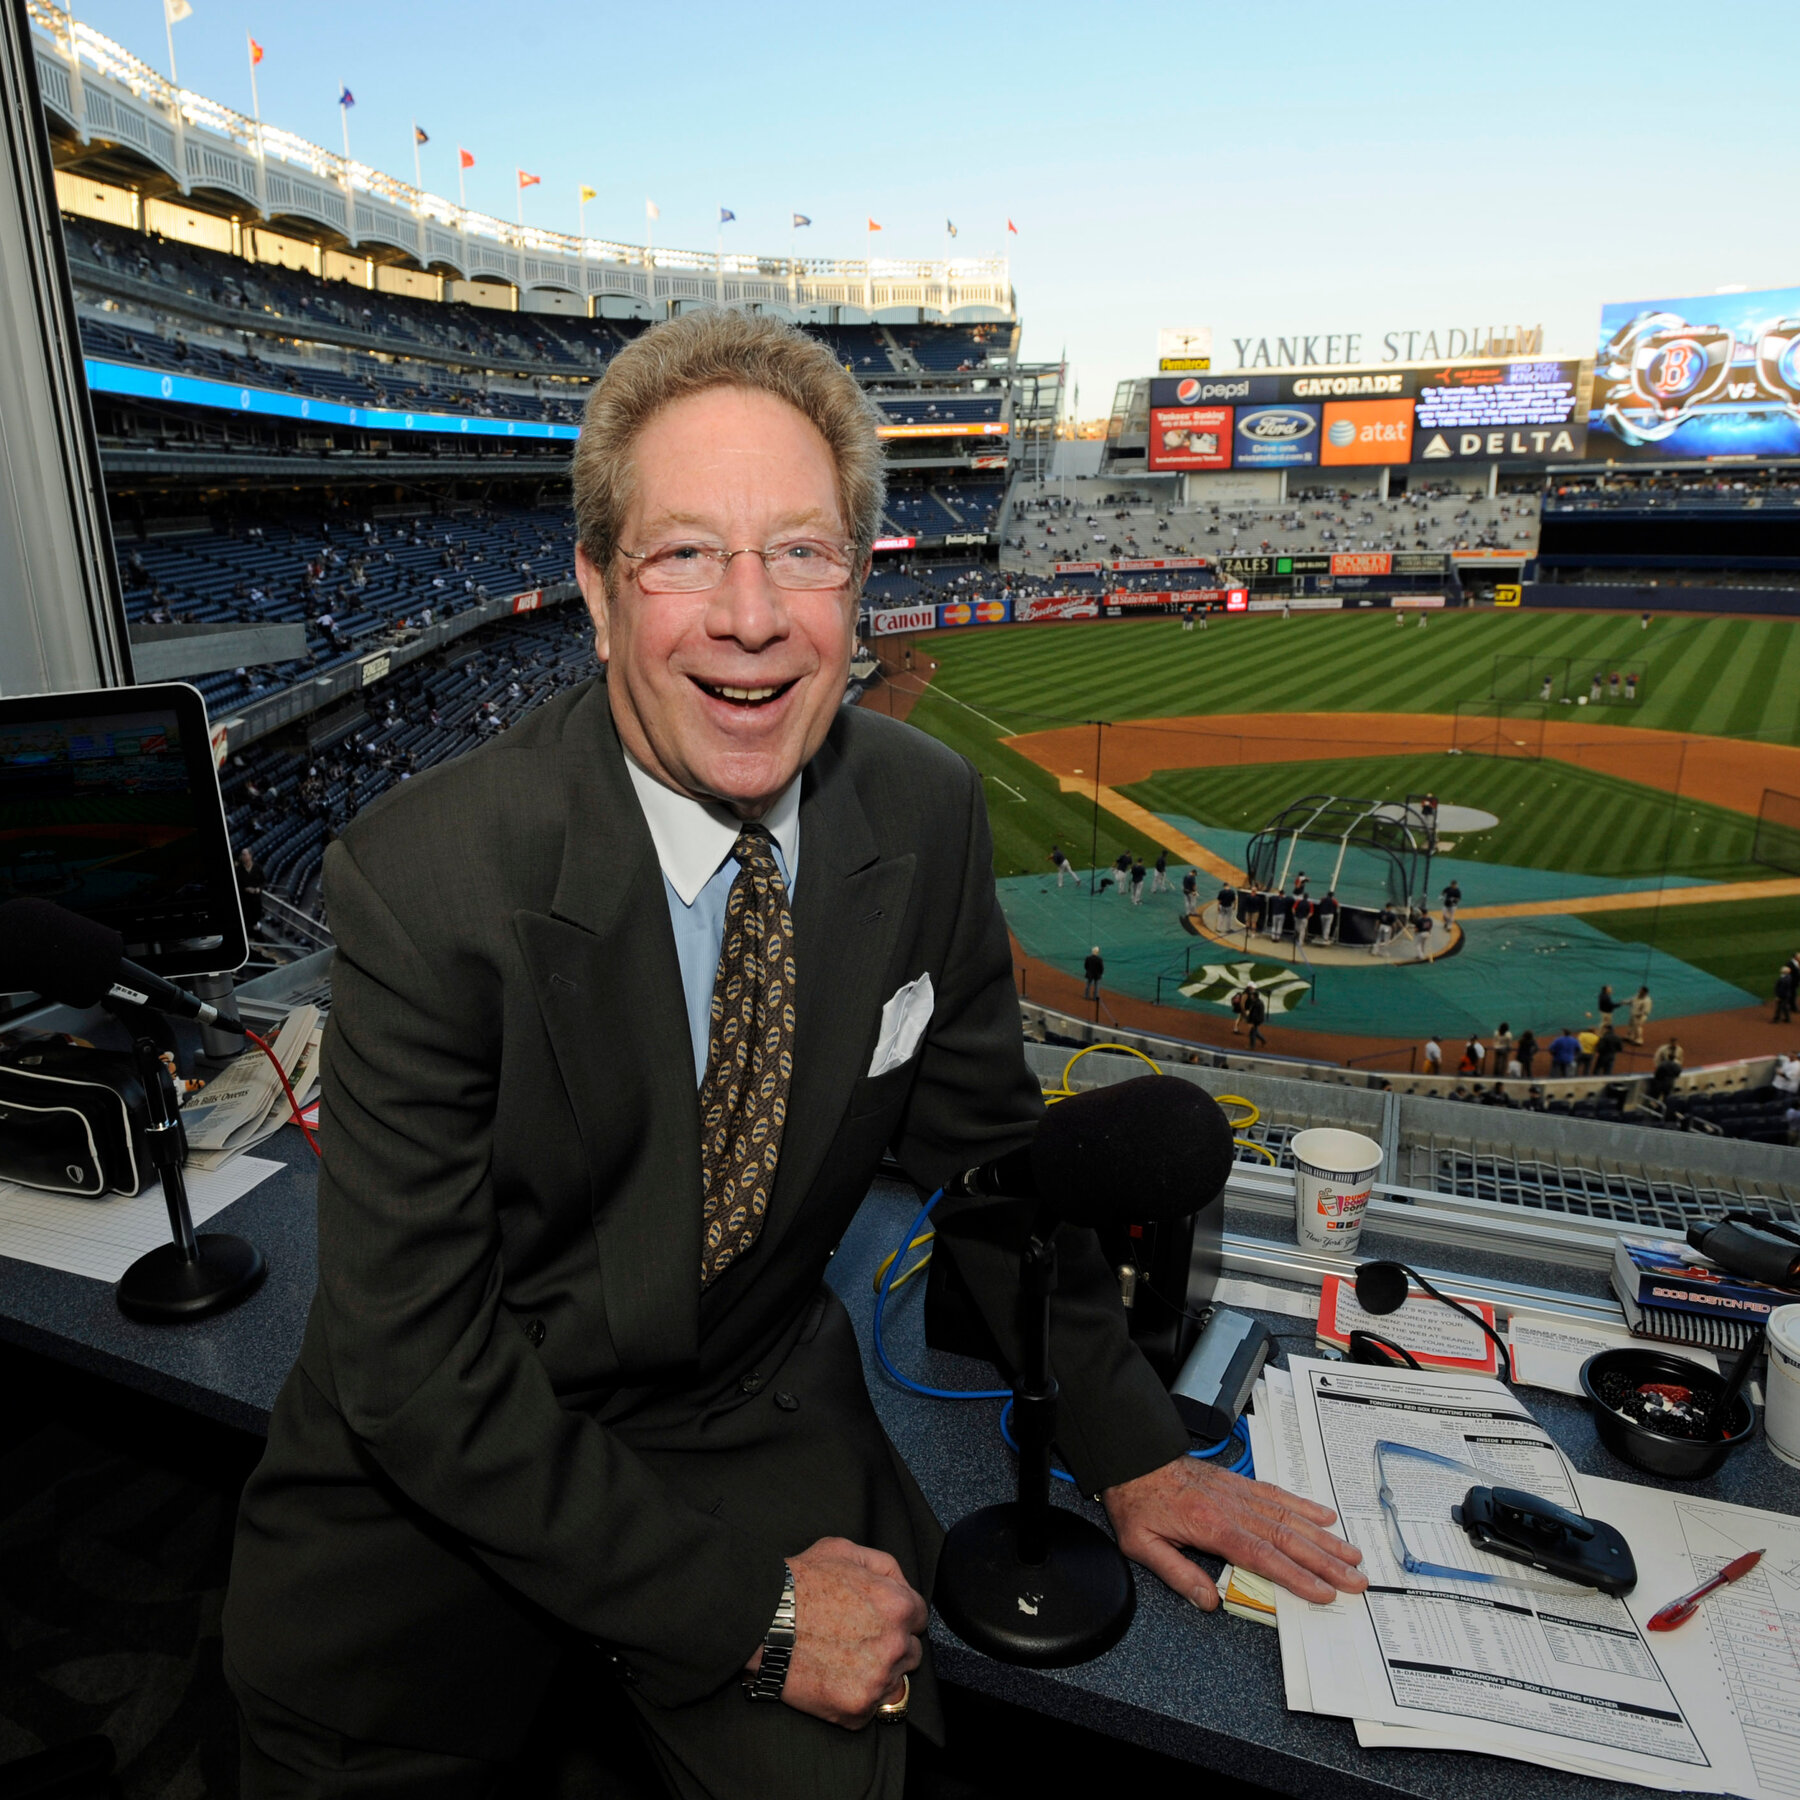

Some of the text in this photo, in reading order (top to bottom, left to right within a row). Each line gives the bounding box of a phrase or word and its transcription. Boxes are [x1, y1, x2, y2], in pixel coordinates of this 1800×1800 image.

[1232, 323, 1544, 368] YANKEE STADIUM
[1655, 343, 1695, 392] B
[1202, 380, 1250, 400] pepsi
[1292, 374, 1403, 397] GATORADE
[1255, 416, 1298, 436] Ford
[1360, 421, 1407, 443] at&t
[1459, 431, 1574, 456] DELTA
[1225, 558, 1269, 572] ZALES
[1333, 554, 1388, 565] SPORTS
[873, 611, 933, 632] Canon
[1652, 1287, 1688, 1300] 2009
[1688, 1292, 1742, 1310] BOSTON
[1743, 1301, 1770, 1314] RED
[1368, 1400, 1403, 1409] TONIGHT'S
[1431, 1407, 1463, 1416] STARTING
[1514, 1439, 1544, 1447] NUMBERS
[1406, 1590, 1459, 1601] BATTER-PITCHER
[1540, 1614, 1568, 1625] STARTING
[1440, 1674, 1487, 1688] MATSUZAKA,
[1451, 1669, 1619, 1709] TOMORROW'S RED SOX STARTING PITCHER
[1661, 1720, 1684, 1729] starts
